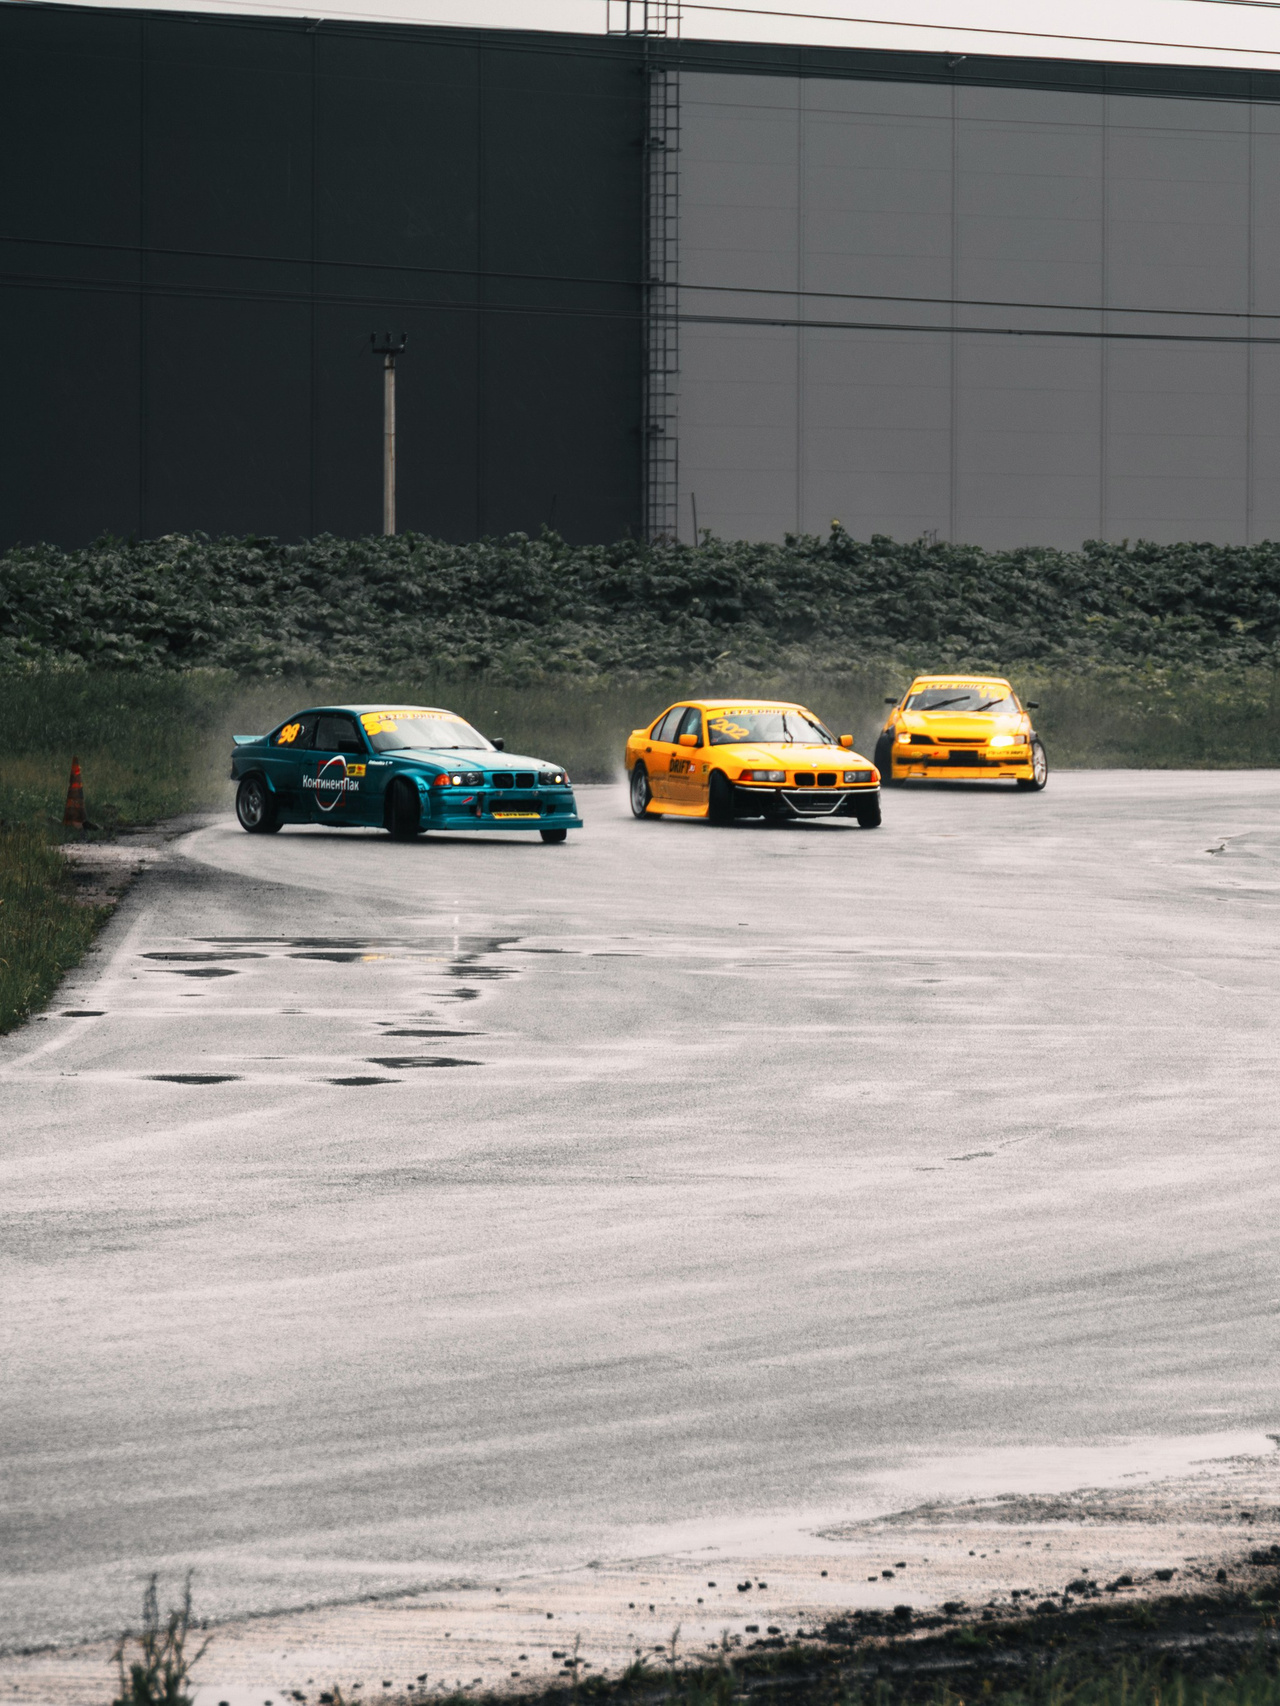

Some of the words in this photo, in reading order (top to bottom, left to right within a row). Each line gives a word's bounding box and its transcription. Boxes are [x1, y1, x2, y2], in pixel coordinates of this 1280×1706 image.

[278, 723, 300, 744] 98
[364, 720, 398, 736] 98
[709, 718, 749, 740] 202
[303, 775, 359, 791] КонтинентПак
